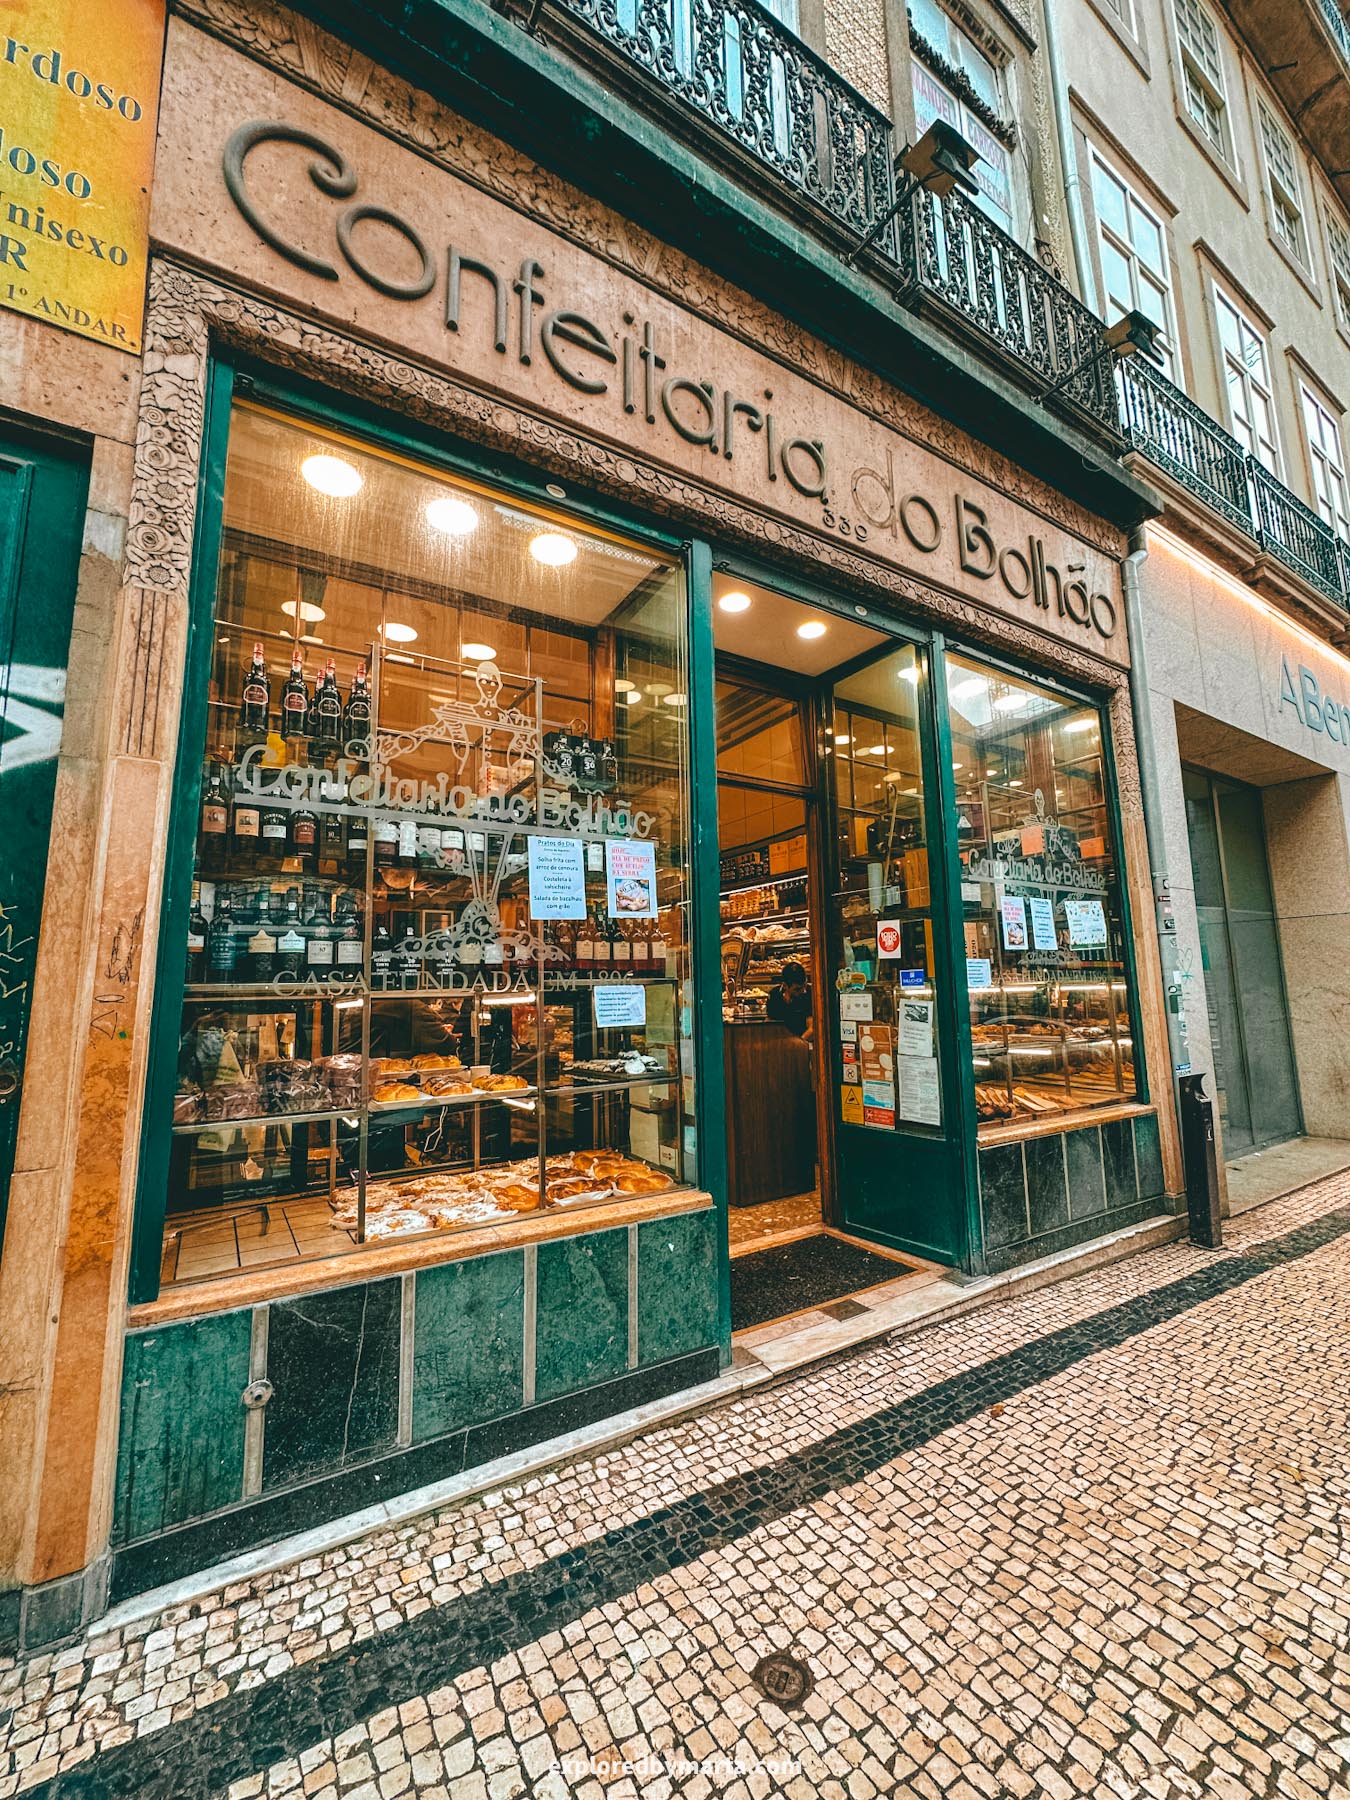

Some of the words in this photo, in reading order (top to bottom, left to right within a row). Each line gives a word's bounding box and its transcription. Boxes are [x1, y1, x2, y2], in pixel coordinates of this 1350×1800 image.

[5, 36, 142, 122] rdoso
[0, 191, 128, 266] nisexo
[222, 119, 829, 504] Confeitaria
[851, 449, 942, 553] do
[955, 494, 1117, 638] Bolhão
[236, 743, 477, 817] Confeitaria
[484, 787, 533, 825] do
[537, 787, 657, 838] Bolhão
[561, 758, 572, 766] 20
[273, 970, 371, 996] CASA
[382, 969, 532, 994] FUNDADA
[541, 970, 578, 992] EM
